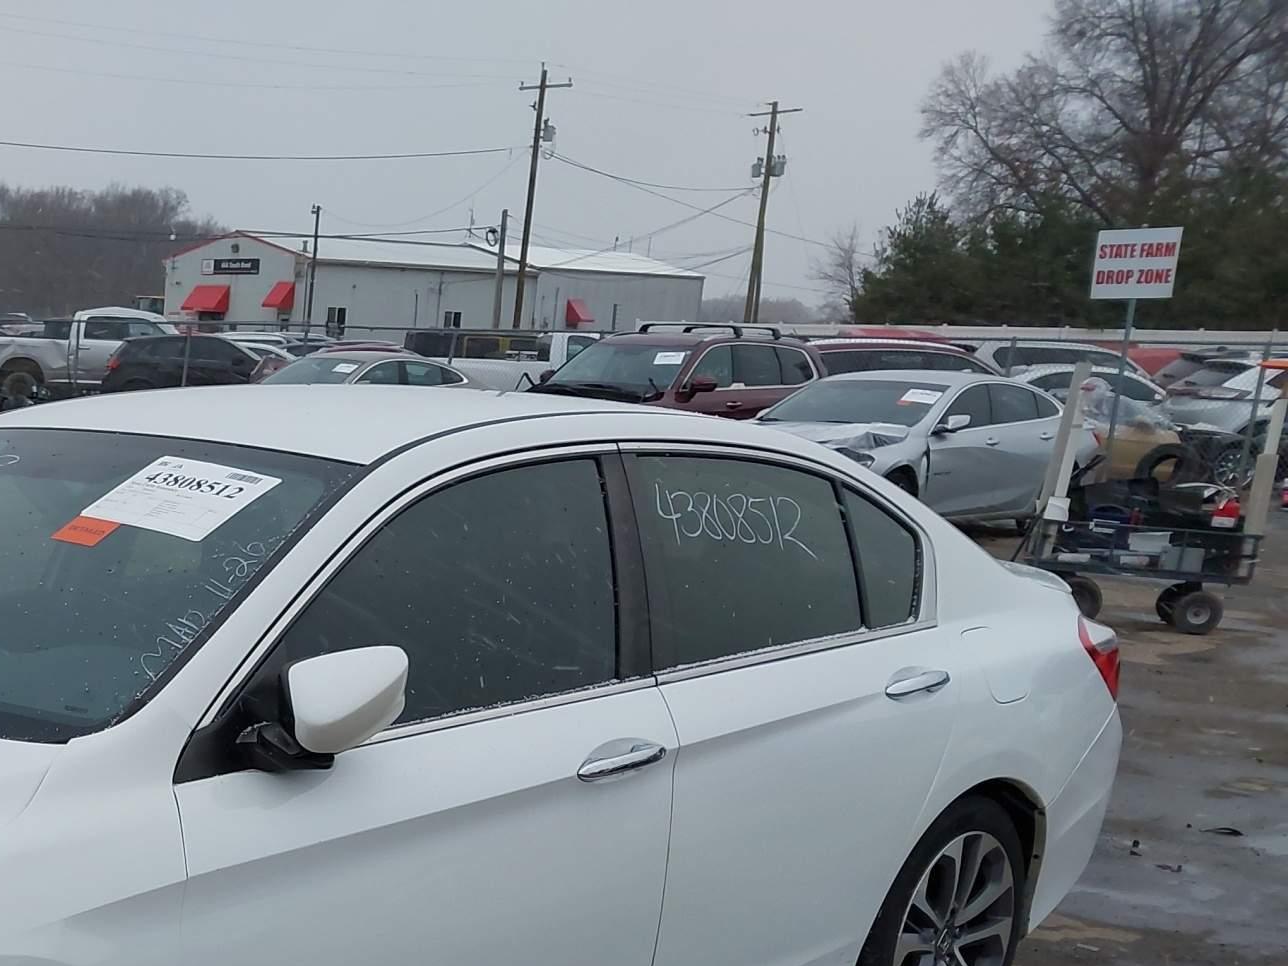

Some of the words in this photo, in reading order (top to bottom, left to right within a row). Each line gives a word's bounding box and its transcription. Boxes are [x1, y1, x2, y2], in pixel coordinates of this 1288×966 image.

[1099, 243, 1137, 259] STATE
[1140, 242, 1177, 258] FARM
[1096, 269, 1134, 285] DROP
[1136, 268, 1173, 284] ZONE
[145, 471, 245, 499] 43808512
[655, 483, 818, 561] 43808512
[205, 541, 266, 600] 11-26
